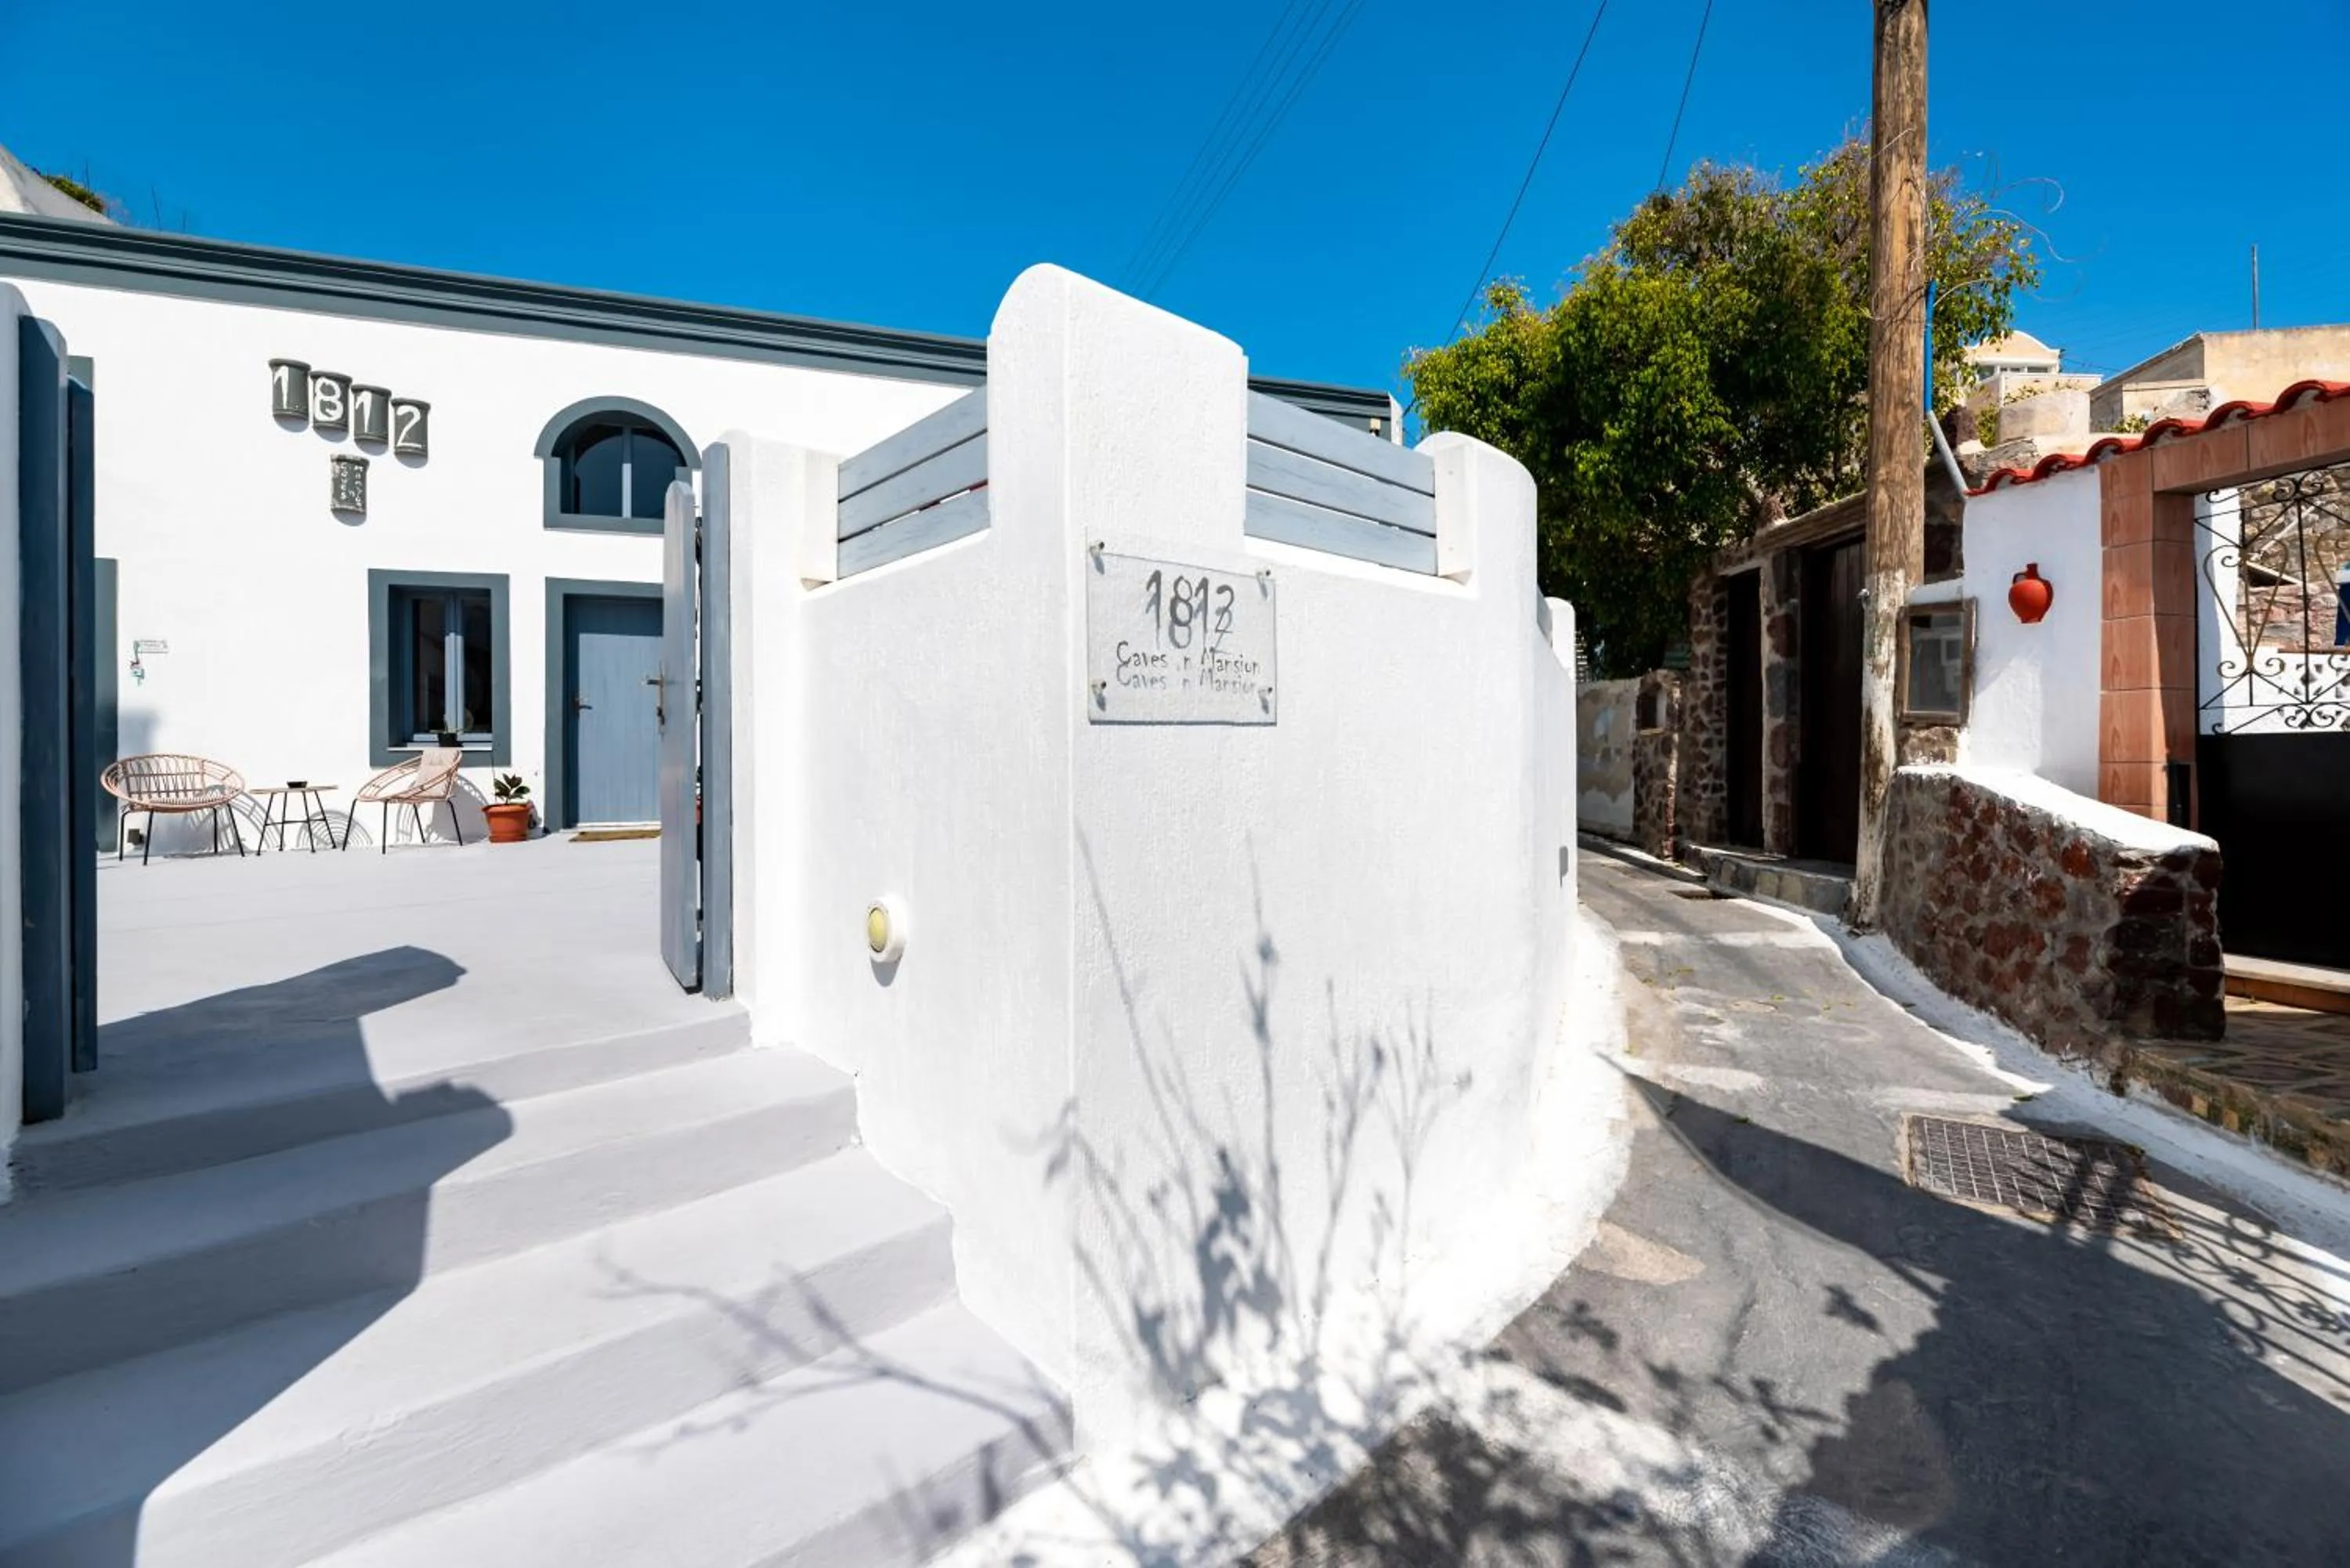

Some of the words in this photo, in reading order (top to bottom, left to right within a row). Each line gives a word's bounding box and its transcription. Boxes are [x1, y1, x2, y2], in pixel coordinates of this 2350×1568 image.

[274, 365, 422, 448] 1812
[1146, 569, 1234, 634] 1812
[1116, 641, 1168, 667] Caves
